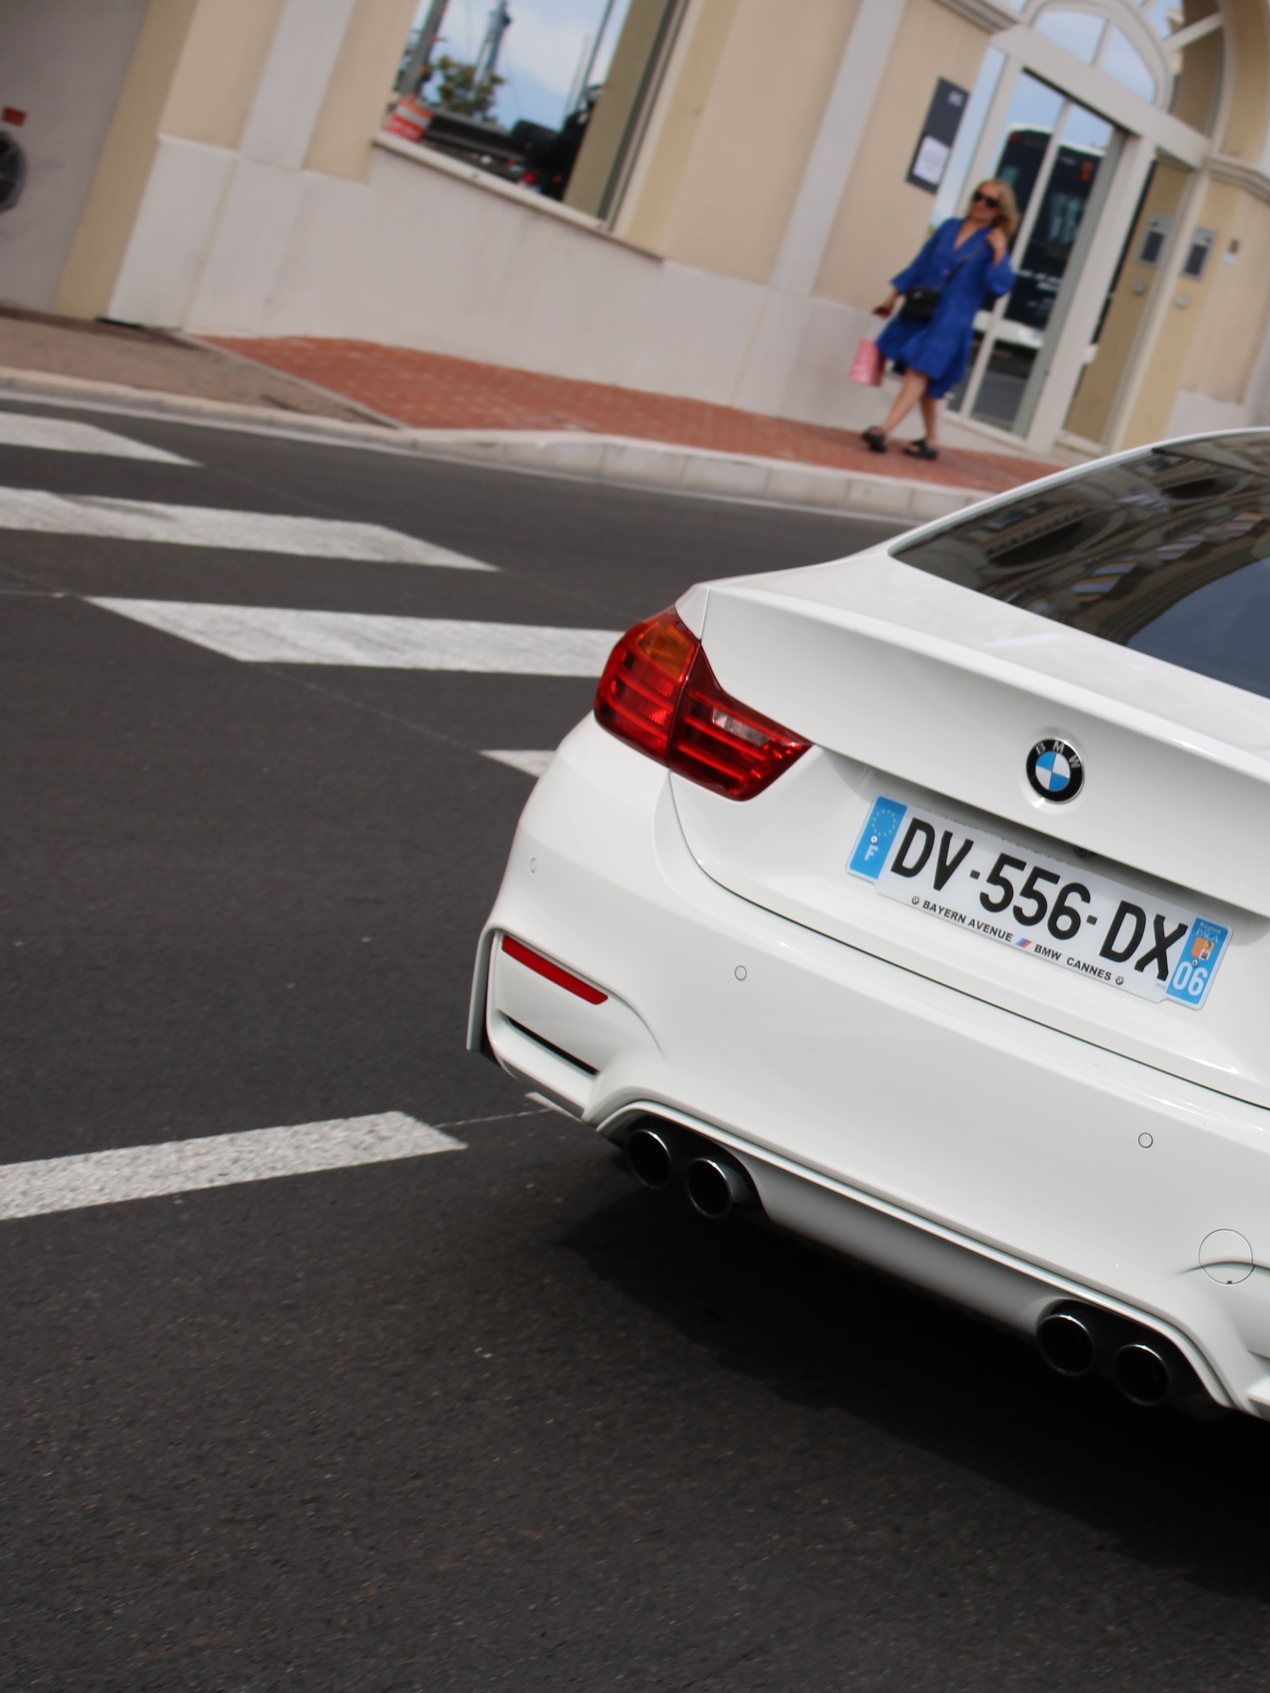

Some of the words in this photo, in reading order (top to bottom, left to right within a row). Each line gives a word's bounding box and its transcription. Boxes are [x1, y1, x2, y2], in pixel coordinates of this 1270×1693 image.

[1035, 740, 1081, 768] BMW
[864, 844, 879, 861] F
[922, 900, 967, 924] BAYERN
[967, 918, 1014, 943] AVENUE
[1034, 944, 1063, 961] BMW
[1066, 957, 1112, 981] CANNES
[1196, 928, 1219, 943] PACA
[1172, 961, 1208, 997] 06
